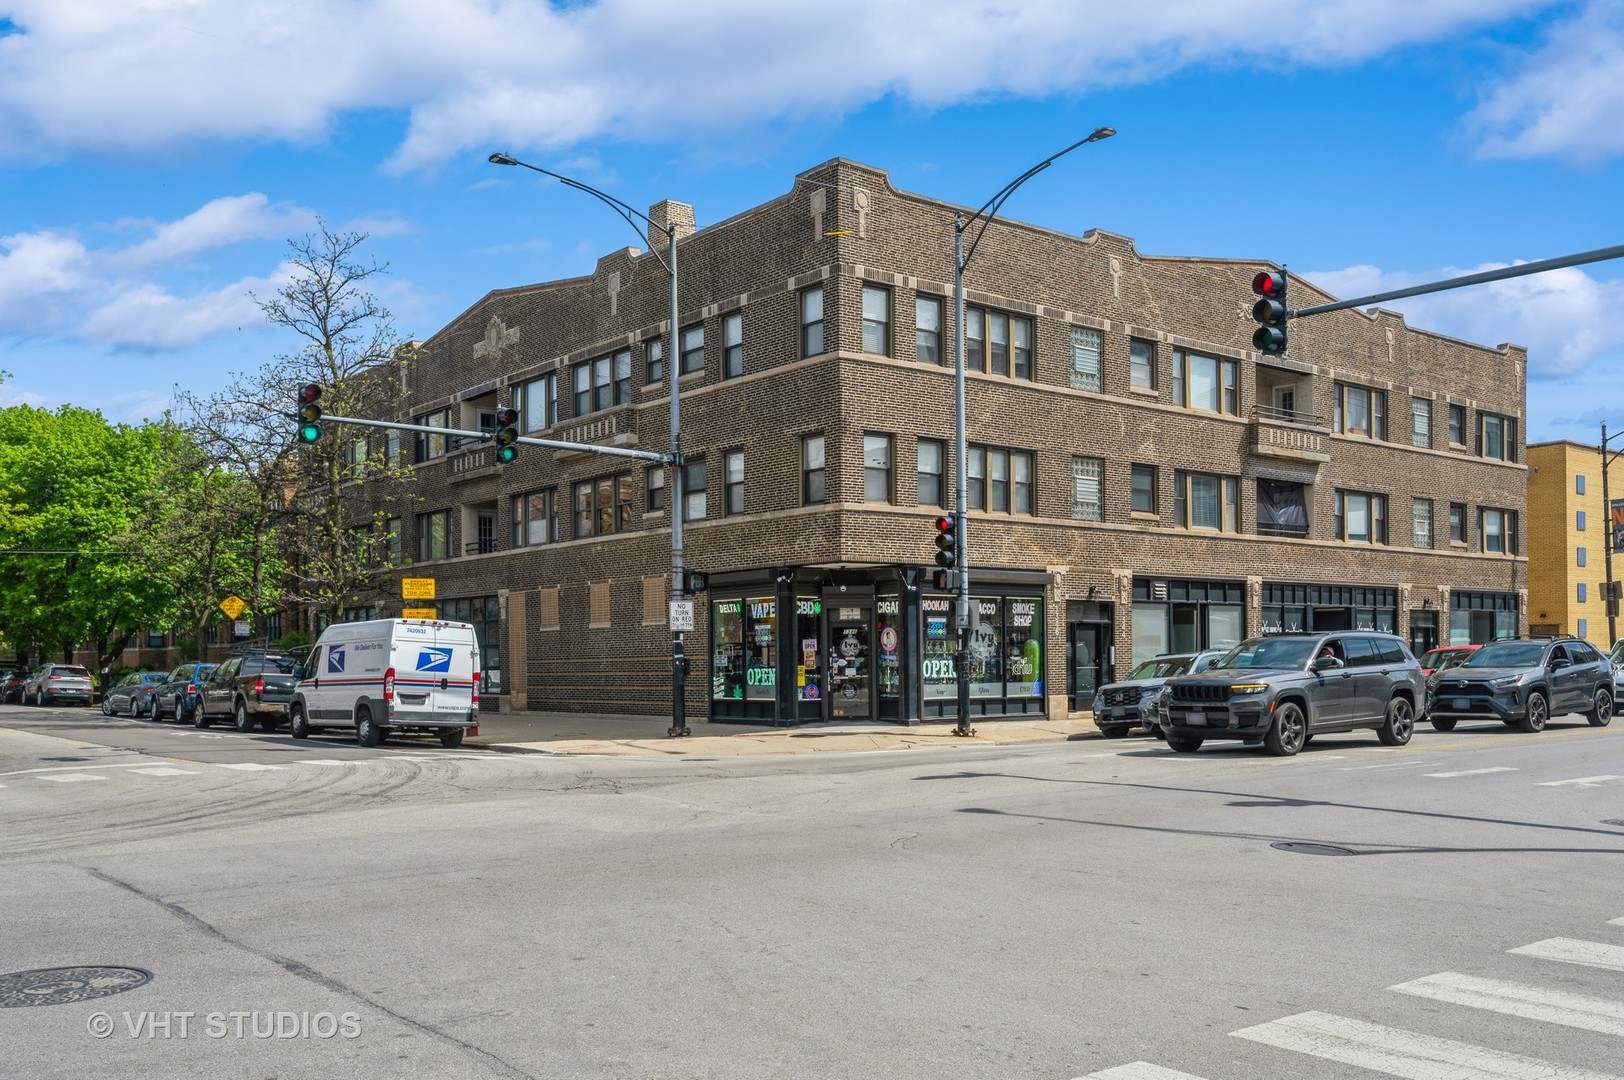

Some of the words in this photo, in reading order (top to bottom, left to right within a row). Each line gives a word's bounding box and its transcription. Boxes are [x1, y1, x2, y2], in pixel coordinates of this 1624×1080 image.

[751, 602, 775, 618] VAPE
[922, 600, 949, 611] HOOKAH
[979, 603, 996, 615] ACCO
[1012, 602, 1035, 615] SMOKE
[1013, 615, 1033, 627] SHOP
[975, 629, 994, 647] Ivy
[747, 668, 776, 685] OPEN
